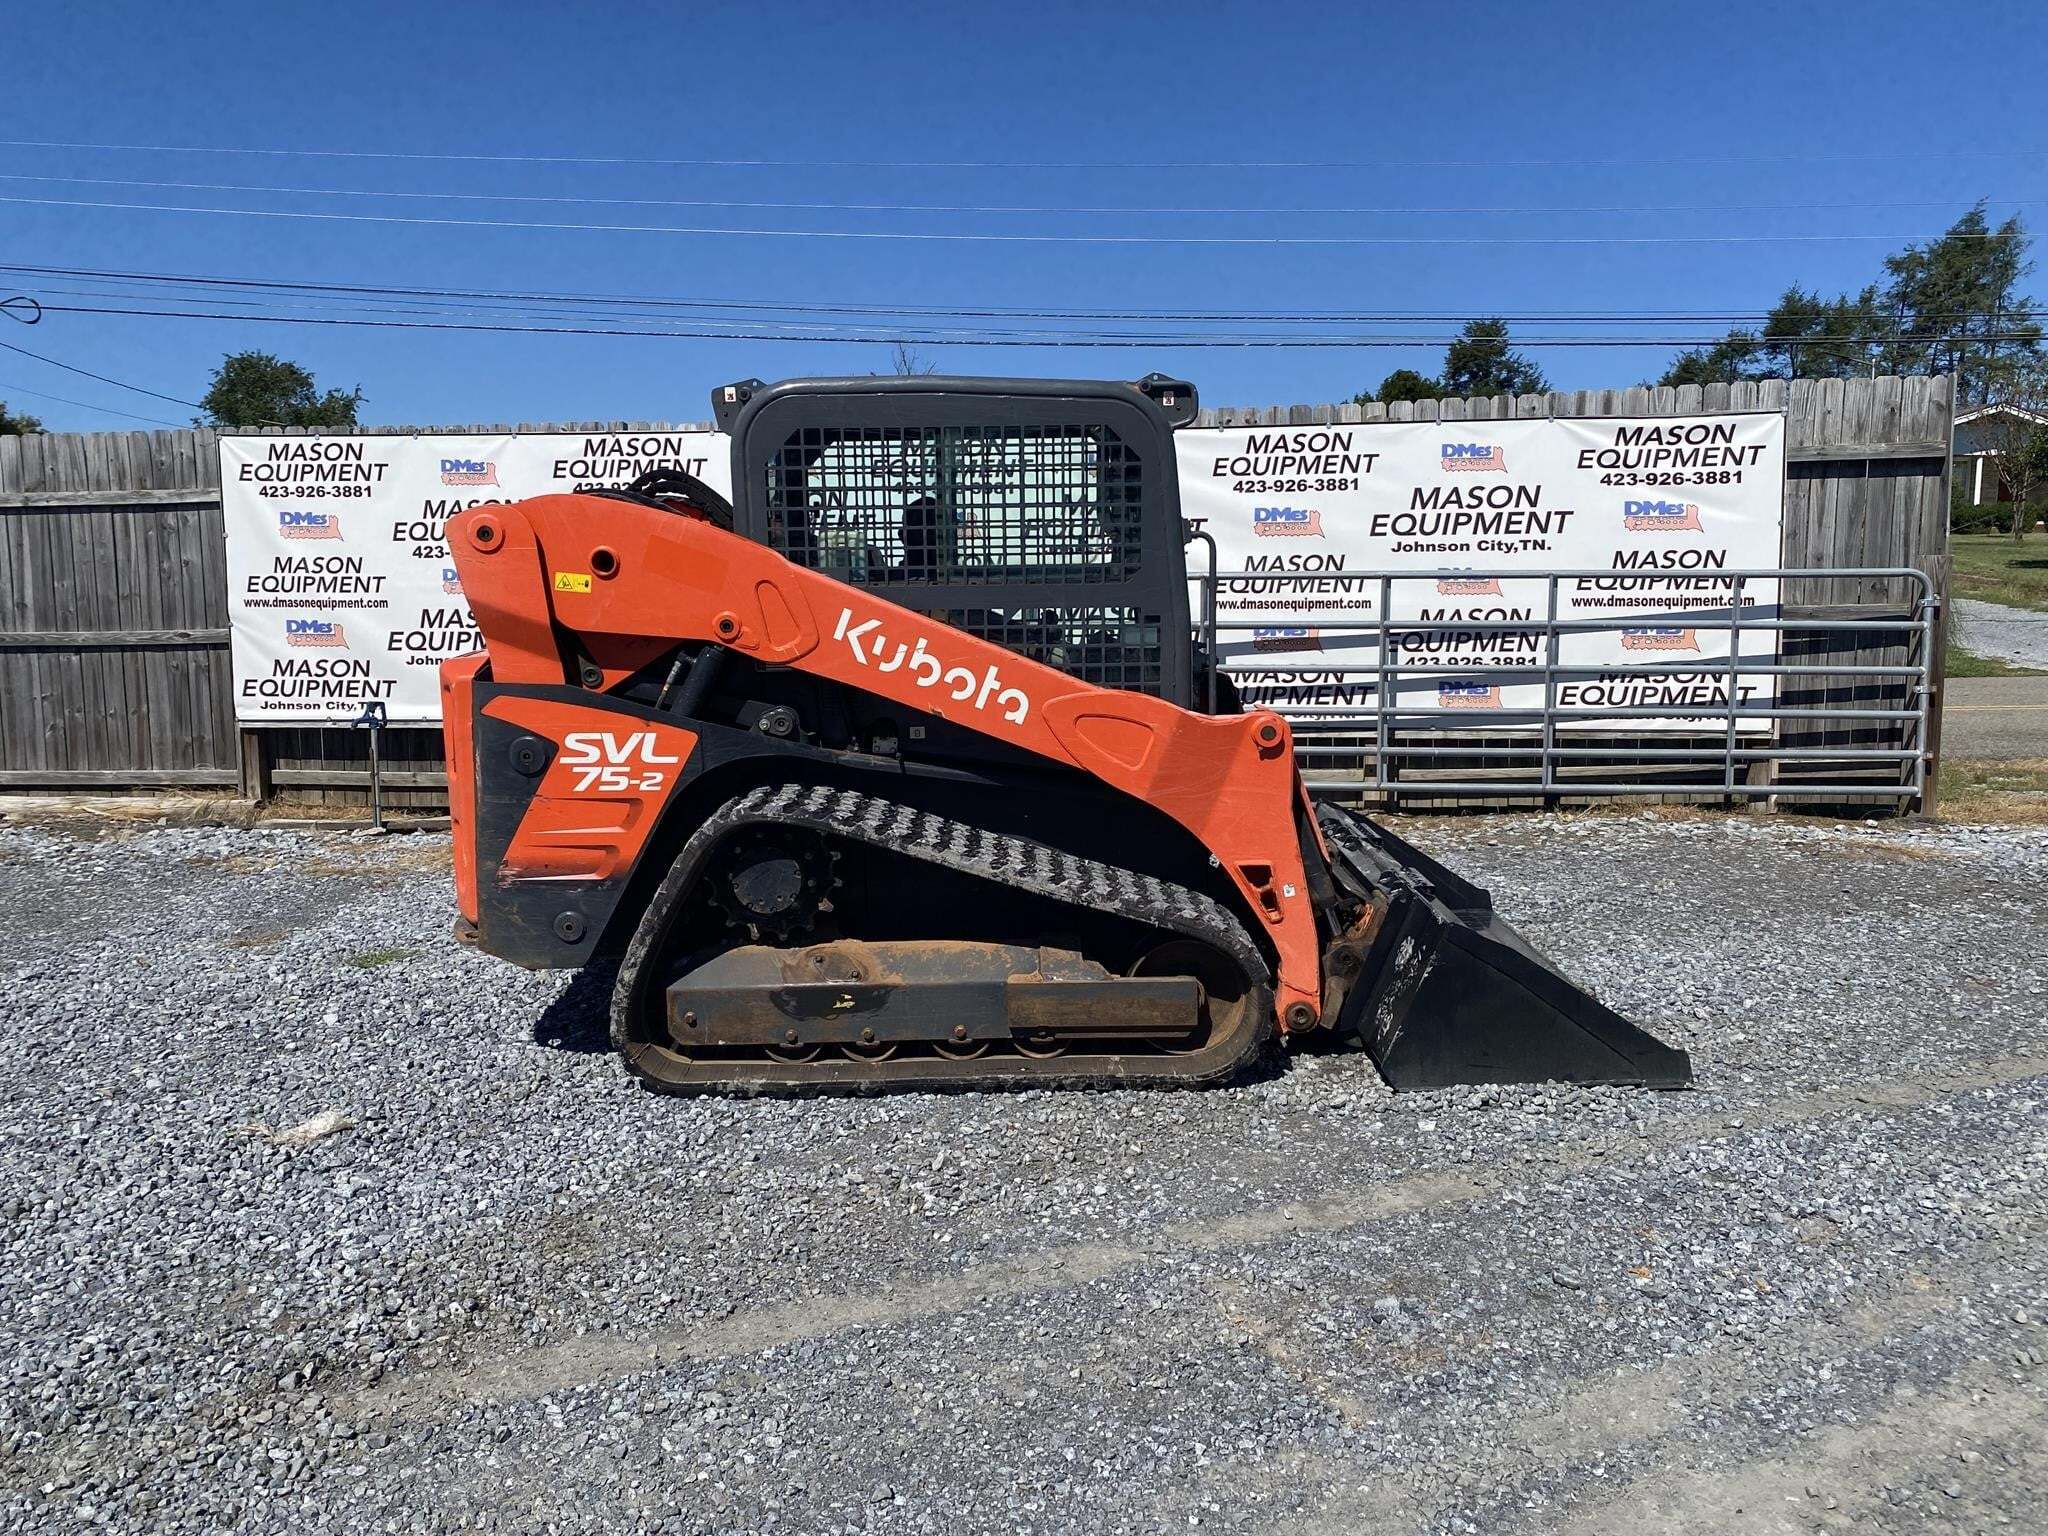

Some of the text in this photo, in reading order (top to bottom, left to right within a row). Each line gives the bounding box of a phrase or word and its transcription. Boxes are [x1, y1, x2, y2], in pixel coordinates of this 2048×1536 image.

[1246, 432, 1353, 454] MASON
[1615, 424, 1736, 446] MASON
[268, 443, 363, 461] MASON
[584, 437, 682, 457] MASON
[1212, 454, 1379, 476] EQUIPMENT
[1577, 445, 1766, 469] EQUIPMENT
[239, 463, 388, 482] EQUIPMENT
[553, 458, 708, 478] EQUIPMENT
[1233, 478, 1359, 493] 423-926-3881
[1600, 471, 1742, 486] 423-926-3881
[259, 486, 372, 497] 423-926-3881
[1410, 485, 1541, 510] MASON
[1370, 511, 1573, 537] EQUIPMENT
[1391, 541, 1469, 552] Johnson
[274, 557, 362, 573] MASON
[1244, 554, 1345, 572] MASON
[1612, 550, 1726, 569] MASON
[247, 576, 386, 593] EQUIPMENT
[244, 597, 389, 610] www.dmasonequipment.com
[1216, 598, 1371, 611] ww.dmasonequipment.com
[420, 609, 477, 628] MAS
[273, 660, 370, 677] MASON
[406, 656, 443, 665] John
[833, 608, 1030, 725] Kubota
[242, 680, 397, 697] EQUIPMENT
[1239, 686, 1375, 705] UIPMENT
[1560, 686, 1756, 706] EQUIPMENT
[260, 702, 320, 710] Johnson
[559, 732, 679, 764] SVL
[572, 766, 664, 792] 75-2
